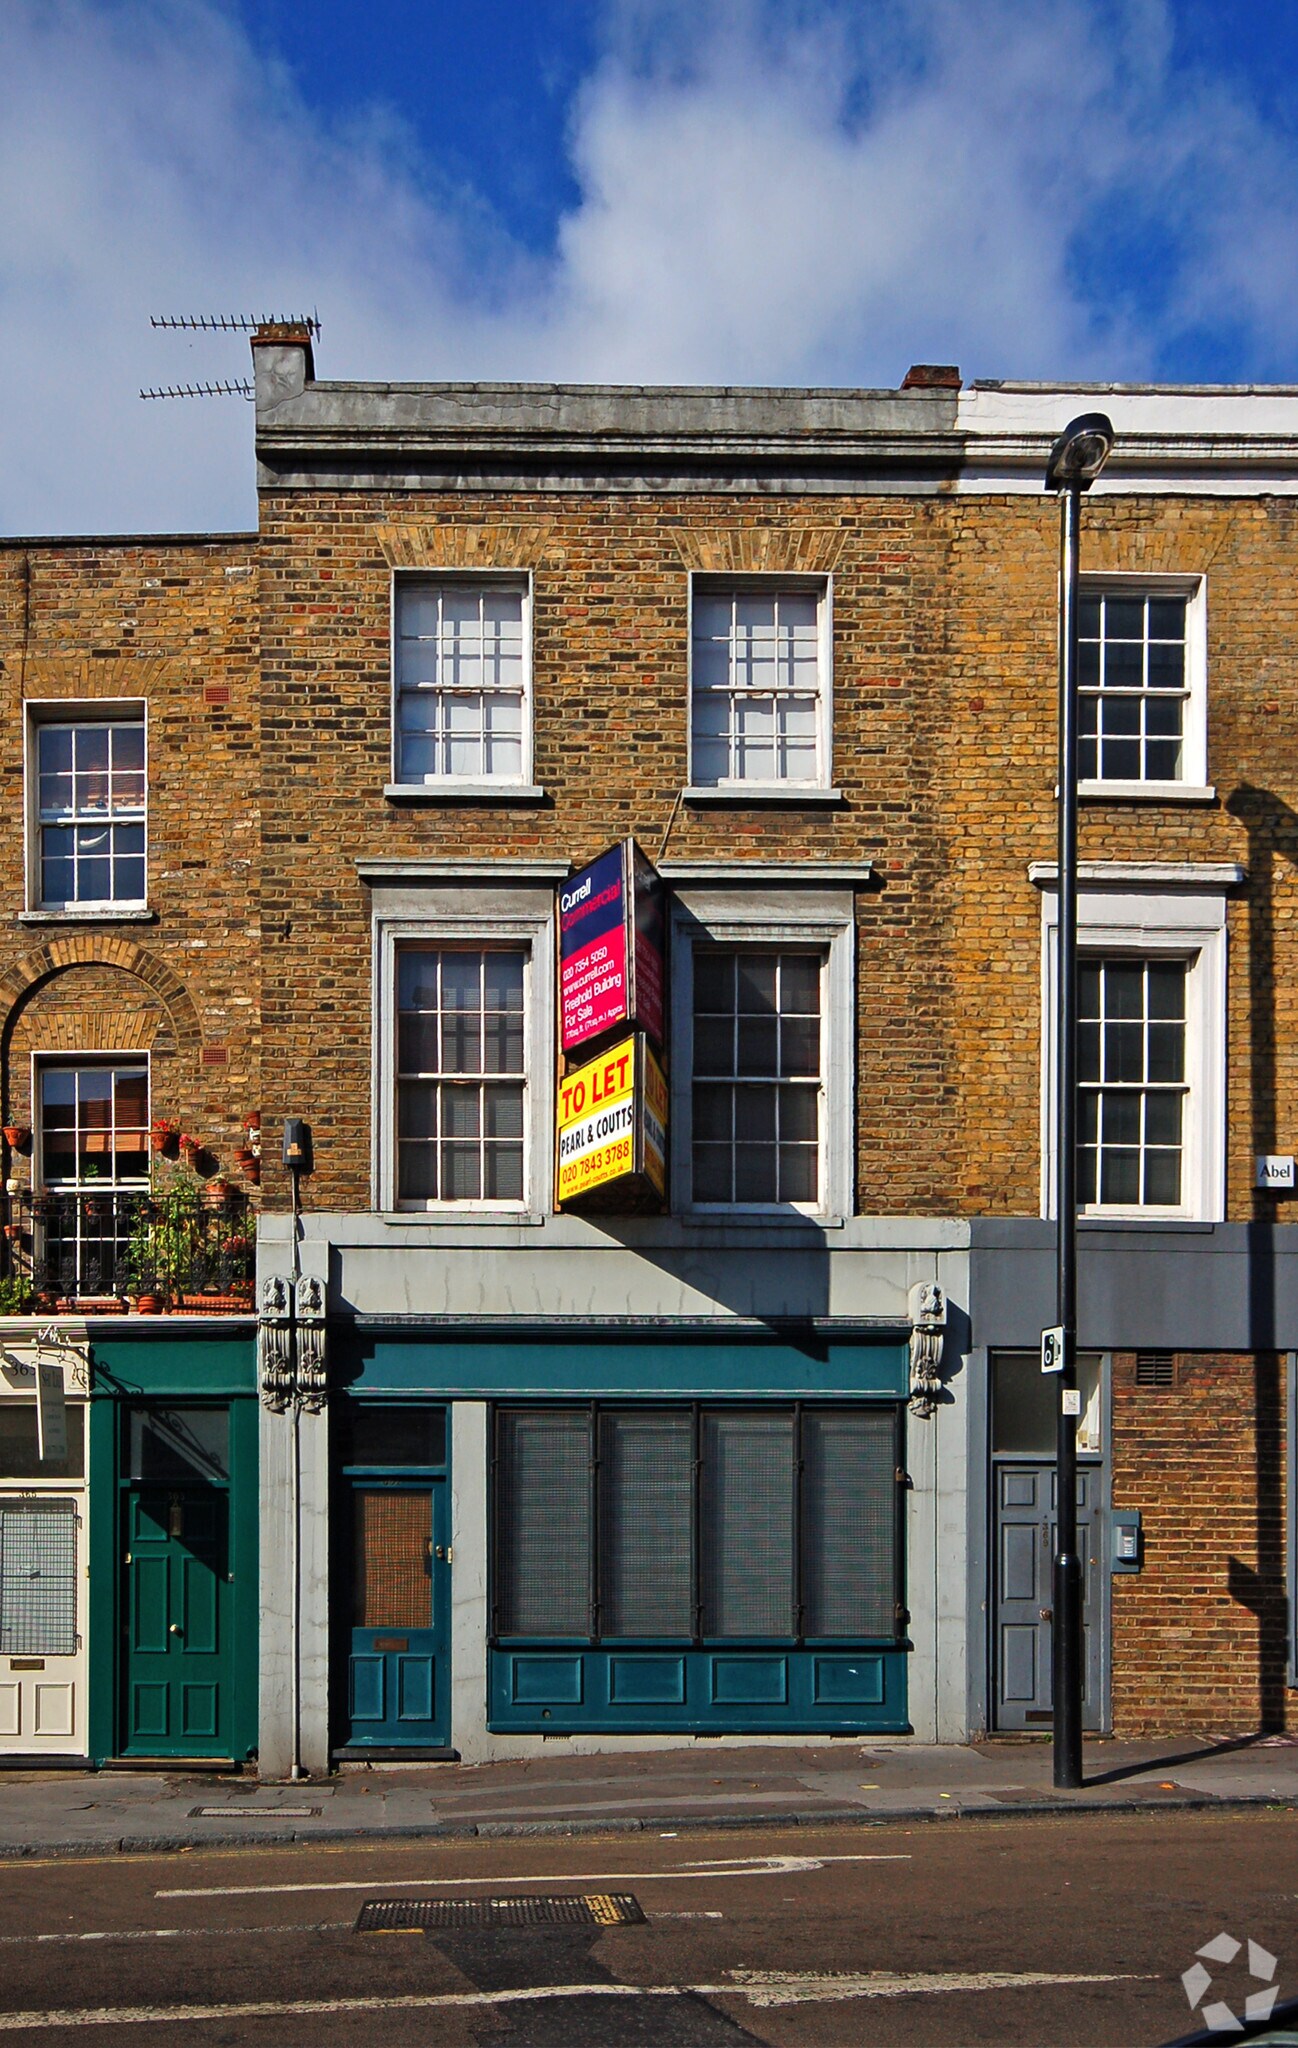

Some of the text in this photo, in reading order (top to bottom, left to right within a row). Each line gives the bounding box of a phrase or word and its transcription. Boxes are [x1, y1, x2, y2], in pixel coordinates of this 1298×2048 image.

[561, 877, 591, 912] Currell
[561, 878, 620, 932] Commercial
[563, 966, 574, 981] 020
[565, 973, 621, 1013] Freehold Building
[565, 1005, 593, 1029] For Sale
[562, 1086, 585, 1119] TO
[592, 1055, 629, 1104] LET
[561, 1128, 585, 1158] PEARL
[587, 1124, 594, 1144] &
[596, 1105, 632, 1139] COUTTS
[562, 1141, 629, 1184] 020 7843 3788
[1259, 1164, 1290, 1178] Abel
